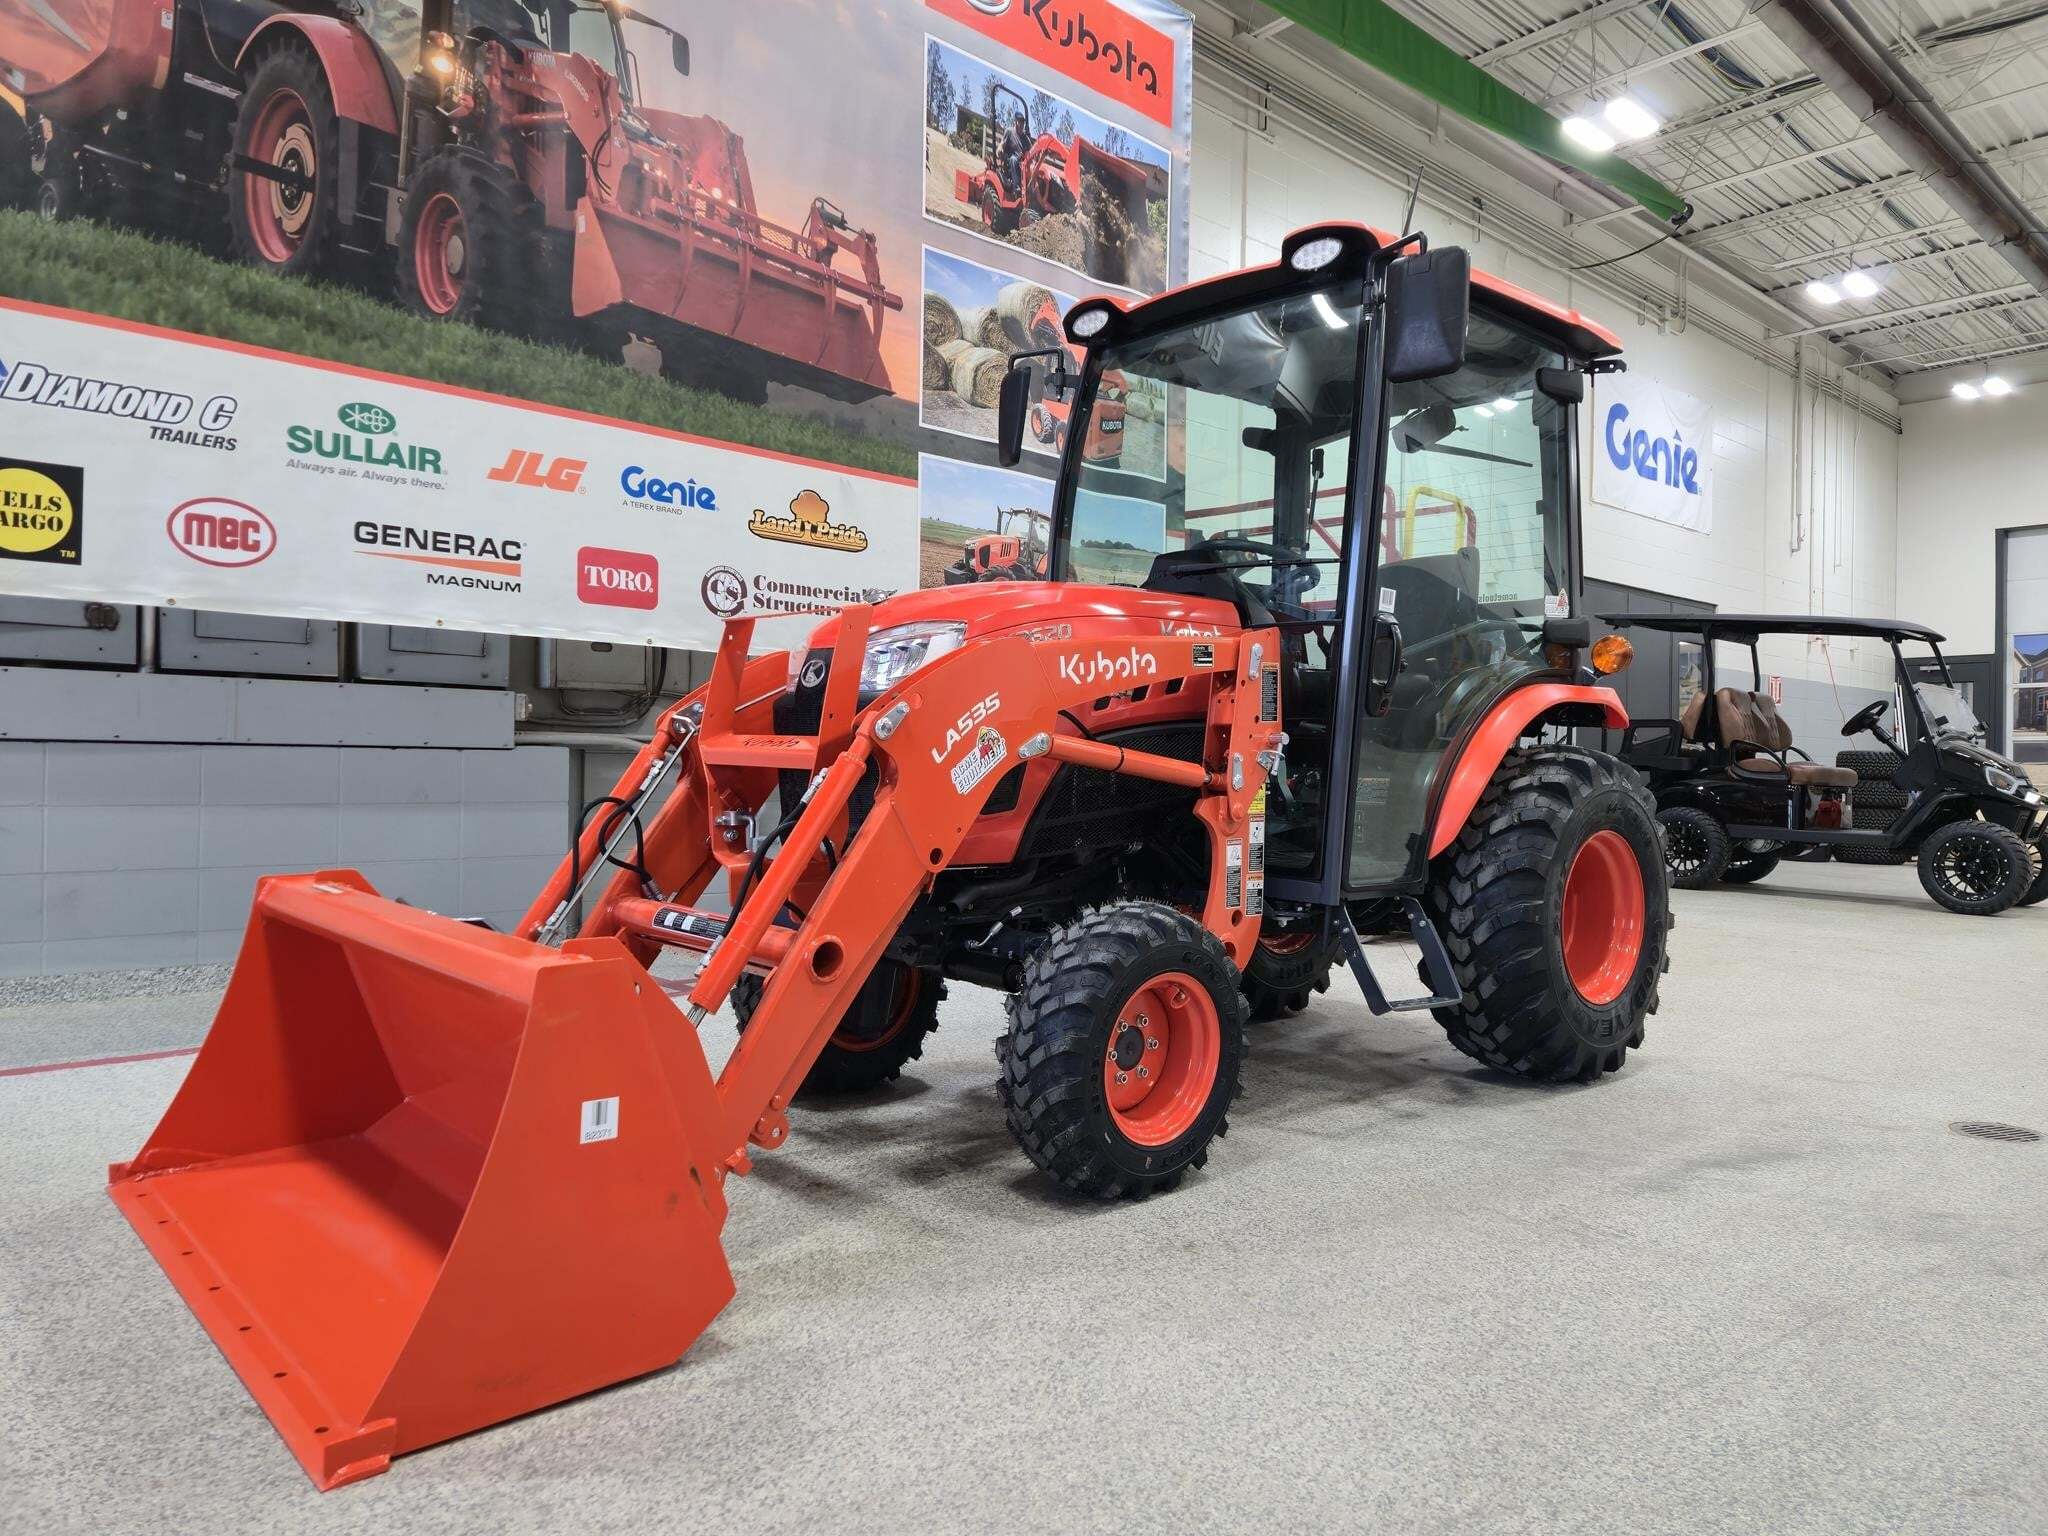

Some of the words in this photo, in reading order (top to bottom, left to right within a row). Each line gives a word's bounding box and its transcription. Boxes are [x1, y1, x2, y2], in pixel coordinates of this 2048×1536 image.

[1023, 0, 1158, 96] Kubota
[1, 362, 193, 425] DIAMOND
[200, 396, 238, 431] C
[149, 426, 238, 451] TRAILERS
[286, 425, 442, 475] SULLAIR
[1606, 402, 1699, 496] Genie
[286, 459, 336, 475] Always
[338, 467, 358, 478] air.
[362, 470, 408, 486] Always
[410, 478, 445, 490] there.
[486, 449, 588, 493] JLG
[620, 465, 716, 512] Genie
[0, 490, 62, 512] ELLS
[622, 499, 629, 507] A
[630, 501, 655, 511] TEREX
[656, 505, 683, 516] BRAND
[0, 511, 64, 532] ARGO
[751, 509, 803, 535] Land
[815, 520, 866, 545] Pride
[354, 521, 522, 561] GENERAC
[427, 573, 522, 593] MAGNUM
[584, 565, 653, 593] TORO
[753, 593, 842, 617] Structur
[1159, 619, 1222, 638] Kubot
[1060, 646, 1157, 684] Kubota
[931, 691, 1001, 764] LA535
[952, 750, 979, 782] ACME
[958, 741, 1007, 794] EQUIPMENT
